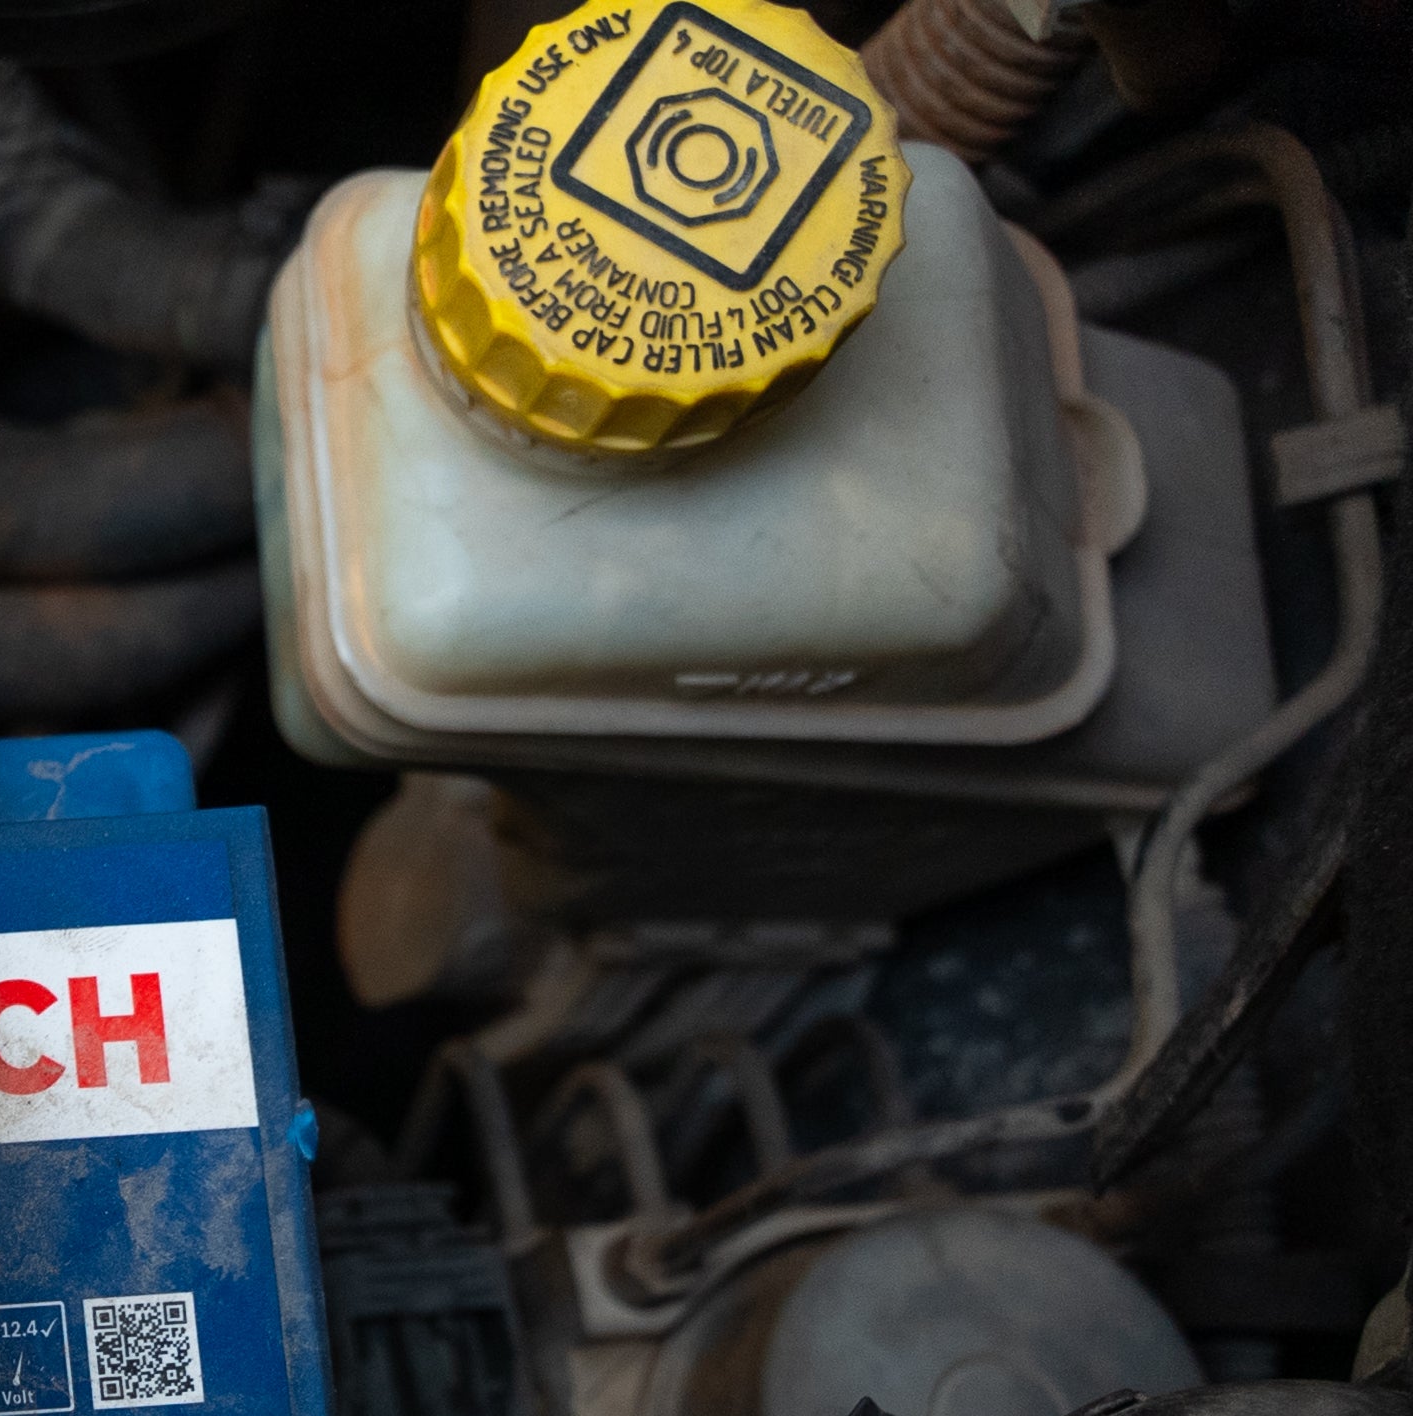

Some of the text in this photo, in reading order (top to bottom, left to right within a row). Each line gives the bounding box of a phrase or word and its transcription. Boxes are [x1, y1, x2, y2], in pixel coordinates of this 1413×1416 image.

[672, 29, 839, 142] TUTELA TOP 4
[479, 9, 888, 374] WARNING! CLEAN FILLER CAP BEFORE REMOVING USE ONLY
[514, 127, 803, 340] DOT 4 FLUID FROM A SEALED
[556, 217, 696, 310] CONTAINER
[0, 1320, 38, 1338] 12.4
[1, 1390, 35, 1406] Volt
